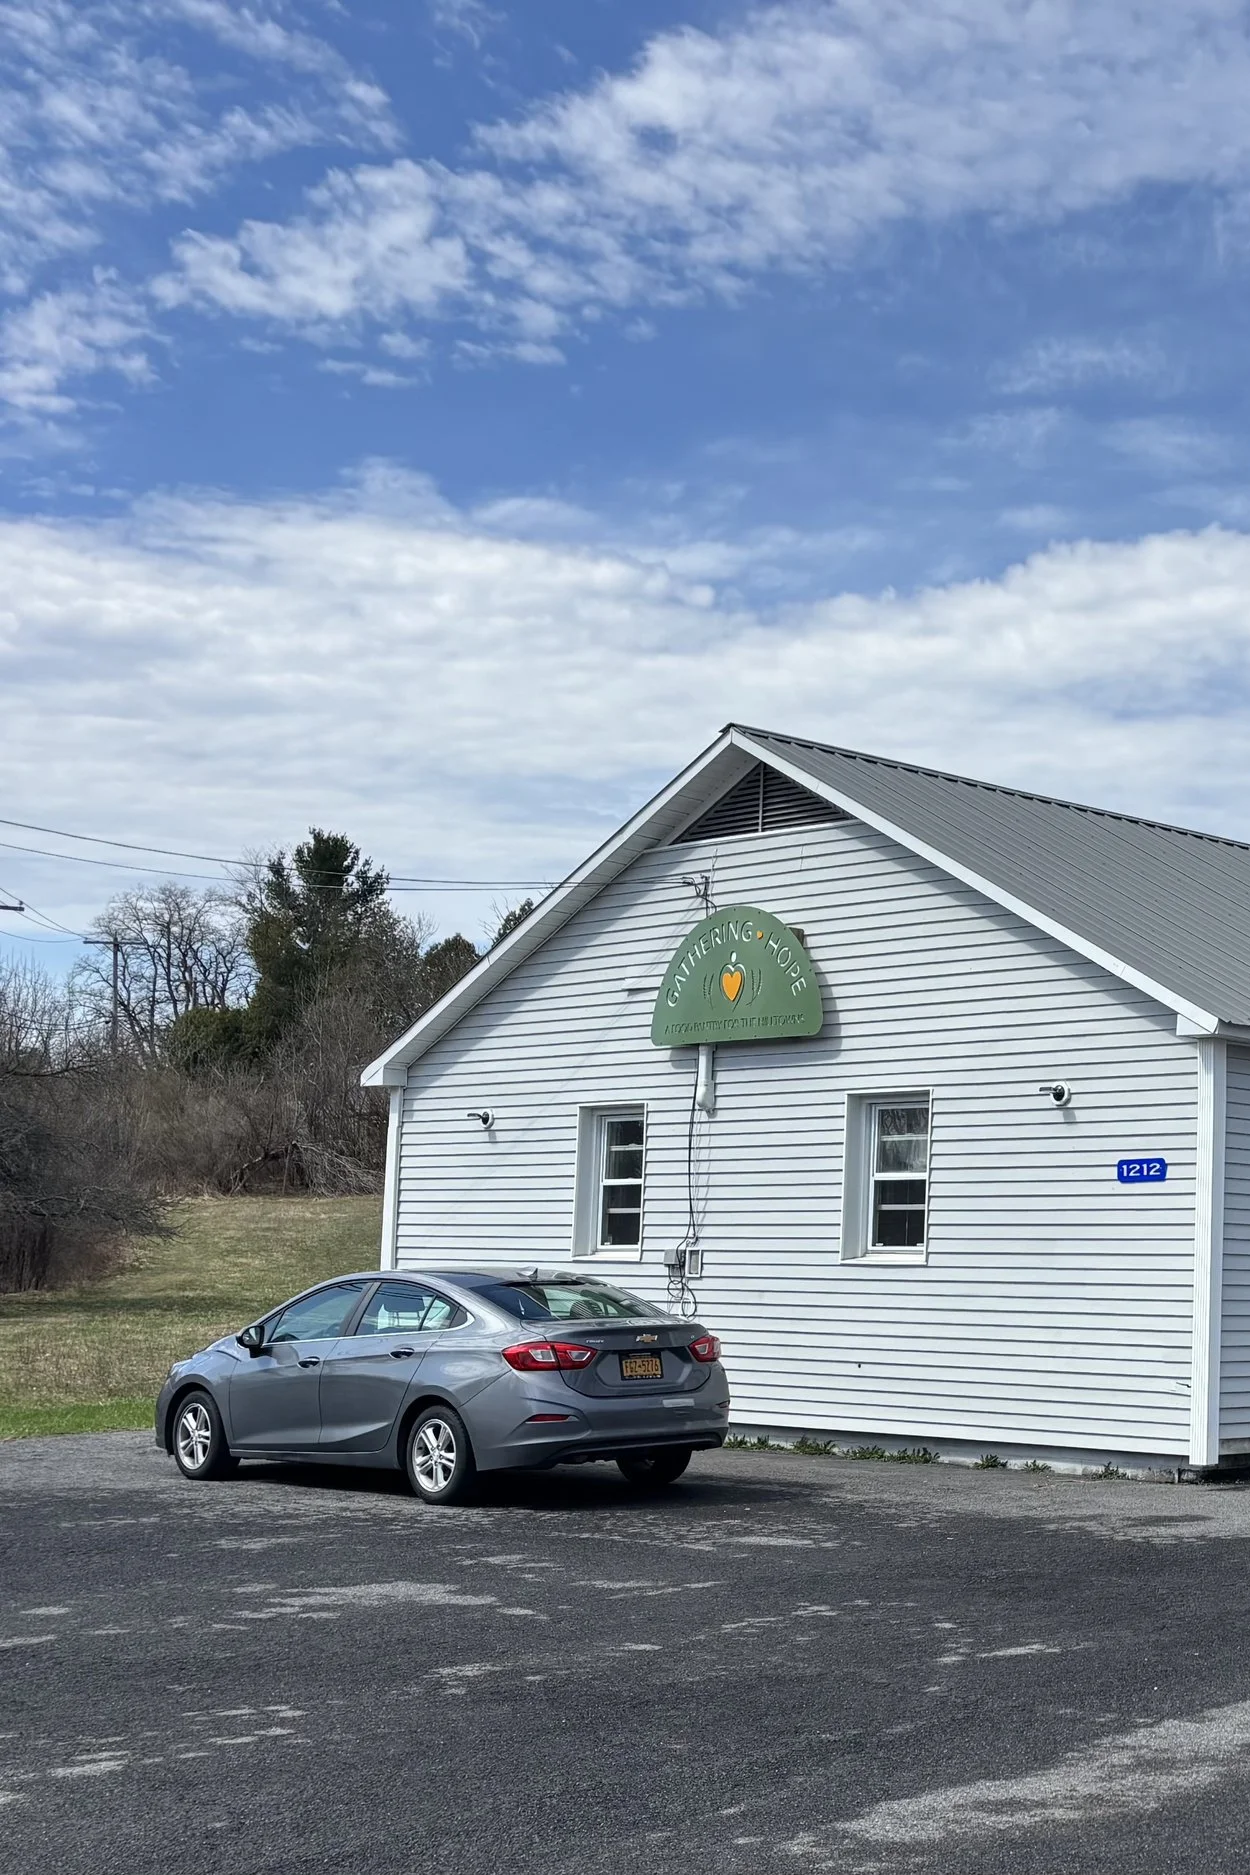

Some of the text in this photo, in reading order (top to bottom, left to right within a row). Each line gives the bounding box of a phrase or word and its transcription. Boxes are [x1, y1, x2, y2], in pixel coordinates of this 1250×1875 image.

[666, 920, 807, 1008] GATHERING HOPE
[664, 1024, 671, 1035] A
[724, 1018, 739, 1030] FOR
[740, 1016, 756, 1028] THE
[1122, 1163, 1161, 1177] 1212
